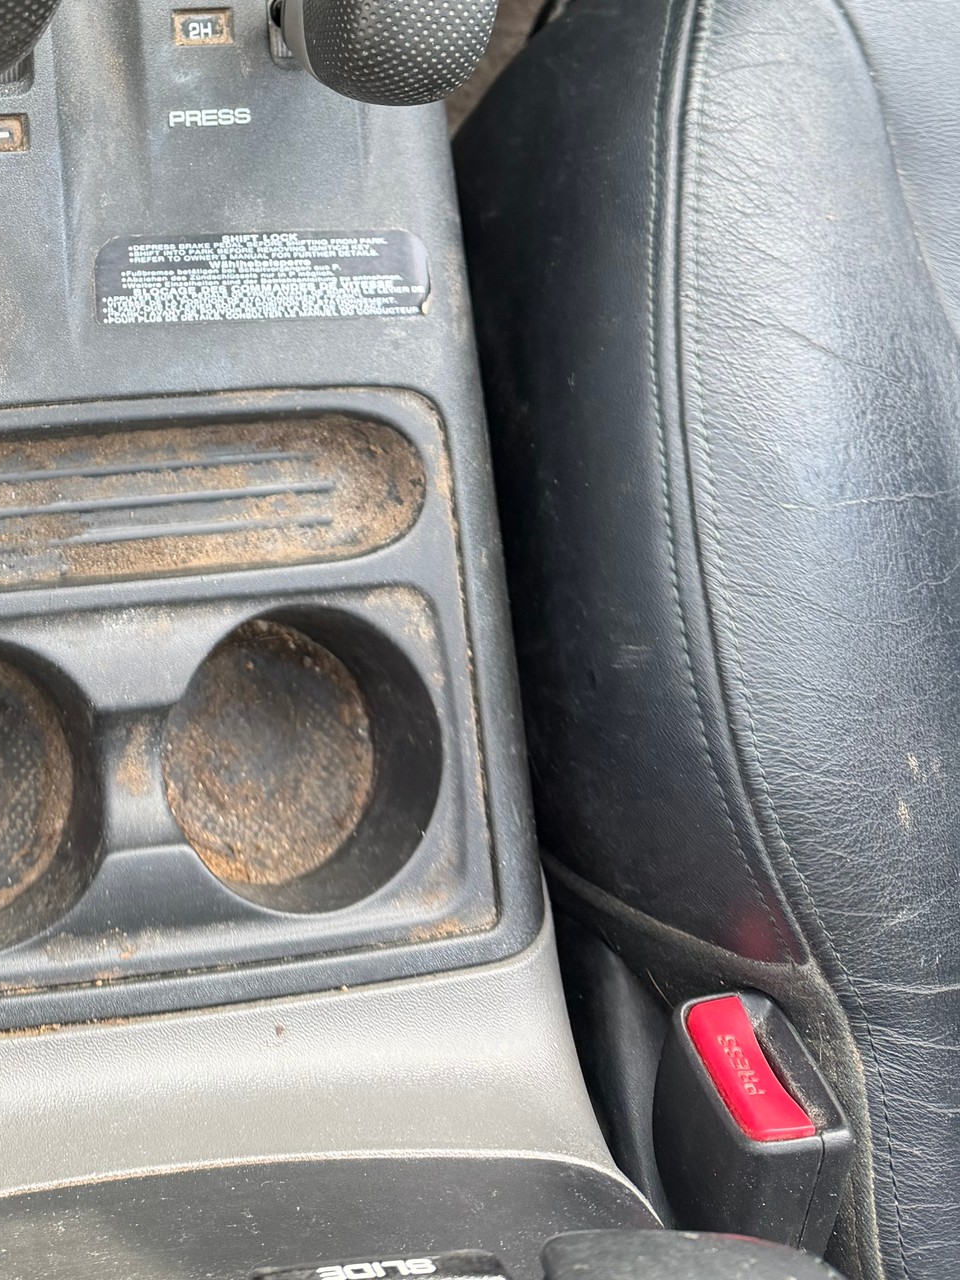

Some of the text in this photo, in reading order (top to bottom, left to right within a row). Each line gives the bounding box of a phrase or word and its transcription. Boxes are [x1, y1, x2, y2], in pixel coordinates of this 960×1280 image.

[188, 22, 212, 39] 2H
[169, 107, 251, 127] PRESS
[222, 232, 297, 242] SHIFT LOCK
[717, 1034, 767, 1096] PRESS
[316, 1258, 436, 1280] SLIDE
